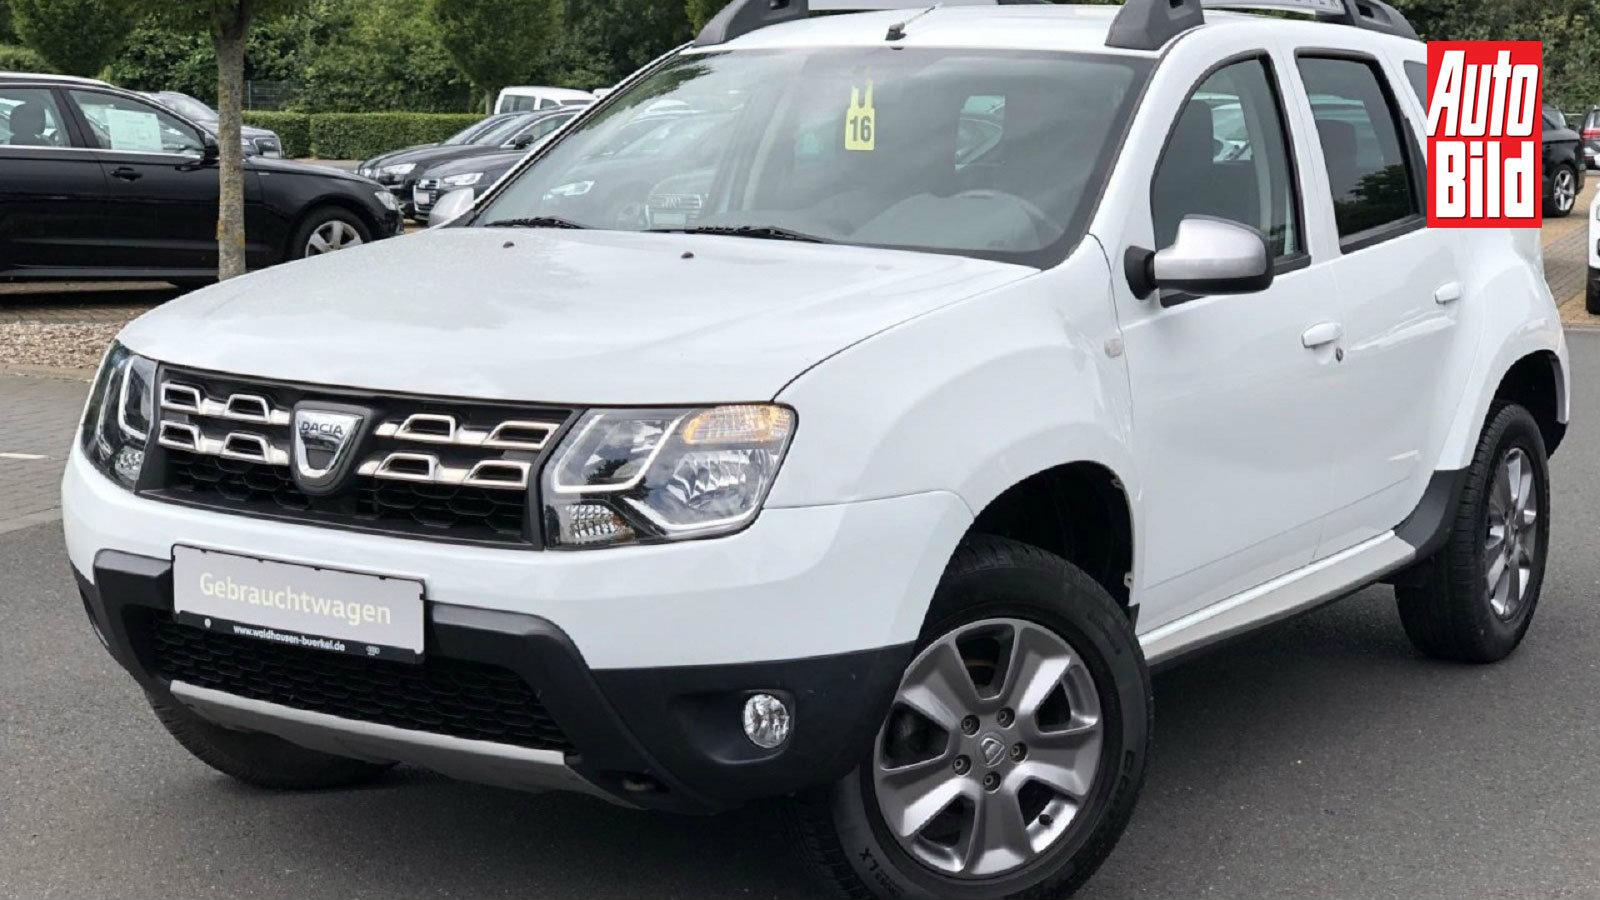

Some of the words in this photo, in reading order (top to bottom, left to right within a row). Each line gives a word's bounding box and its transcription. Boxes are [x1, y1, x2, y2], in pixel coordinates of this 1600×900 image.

[850, 115, 872, 142] 16
[301, 420, 343, 436] DACIA
[199, 572, 392, 626] Gebrauchtwagen
[233, 624, 346, 652] www.waldhausen-buerkel.de
